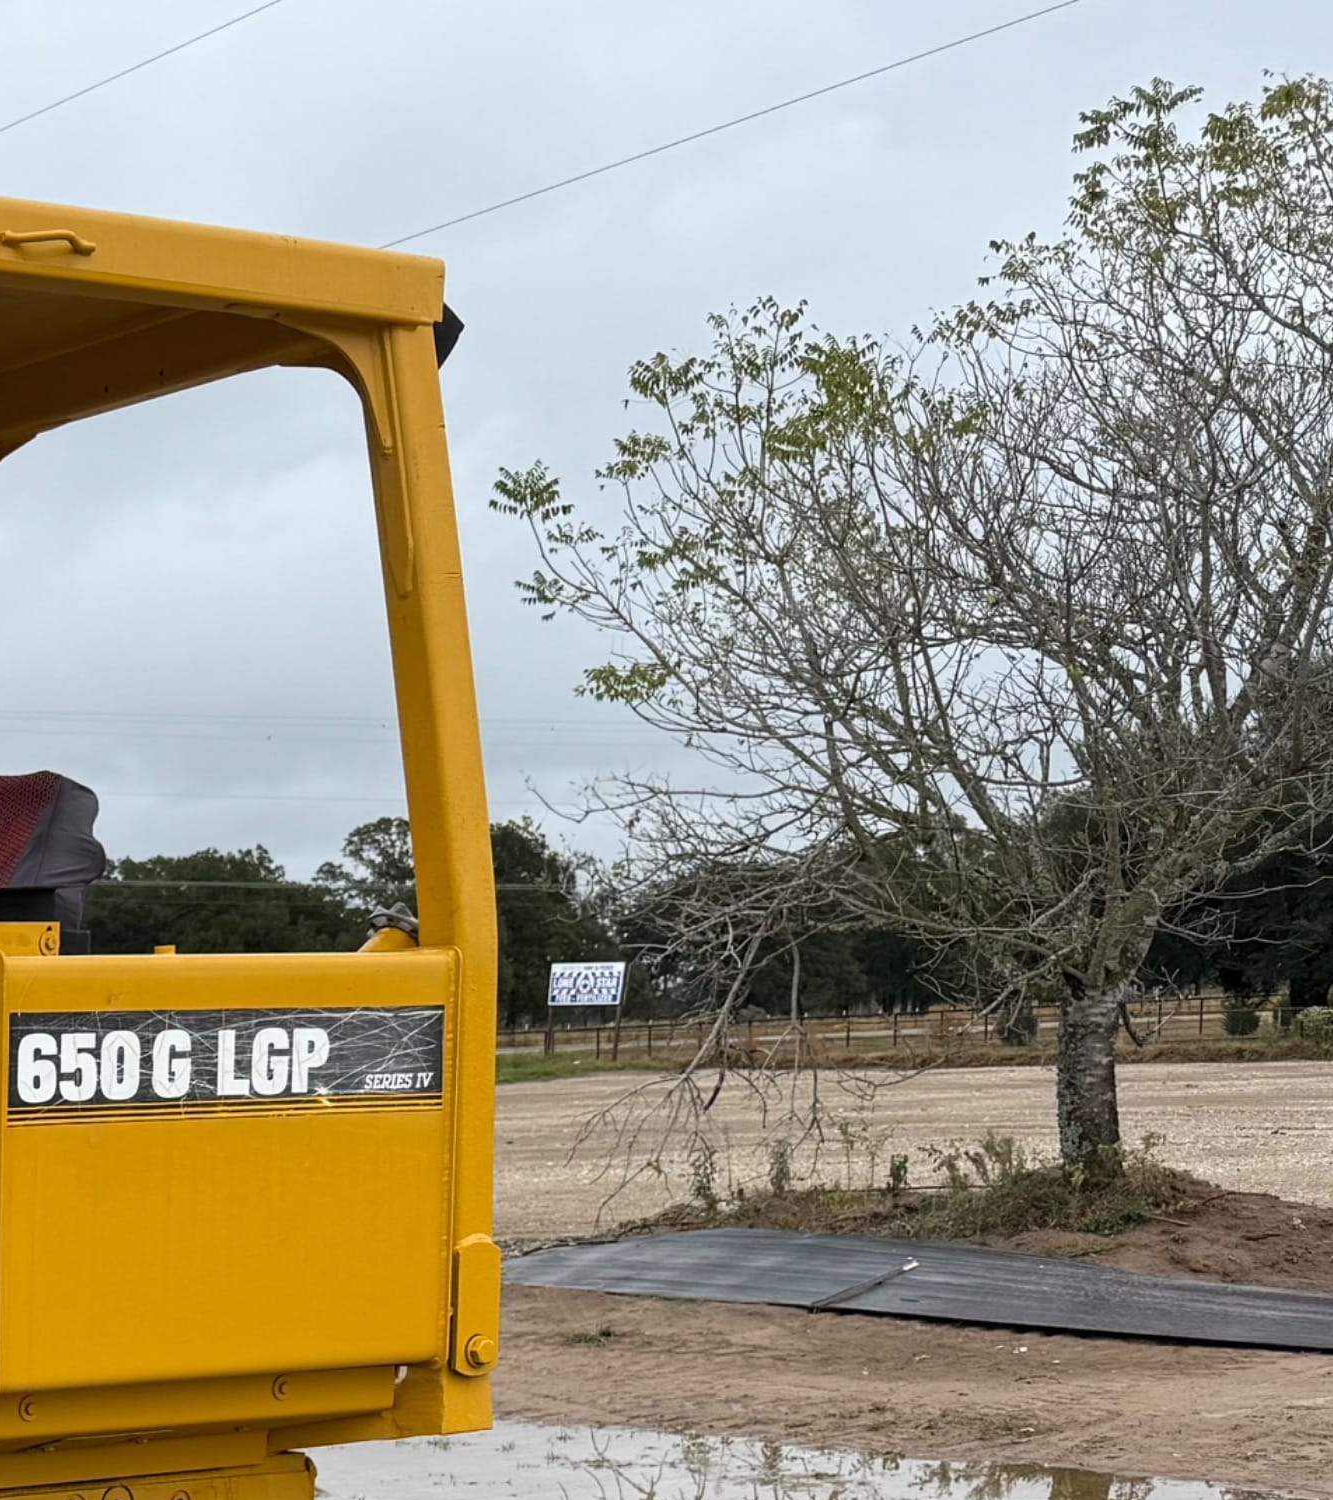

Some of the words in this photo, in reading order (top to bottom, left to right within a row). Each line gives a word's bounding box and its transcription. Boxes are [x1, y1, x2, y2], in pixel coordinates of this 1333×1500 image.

[216, 1027, 330, 1098] LGP
[364, 1073, 413, 1090] SERIES
[415, 1071, 434, 1089] IV
